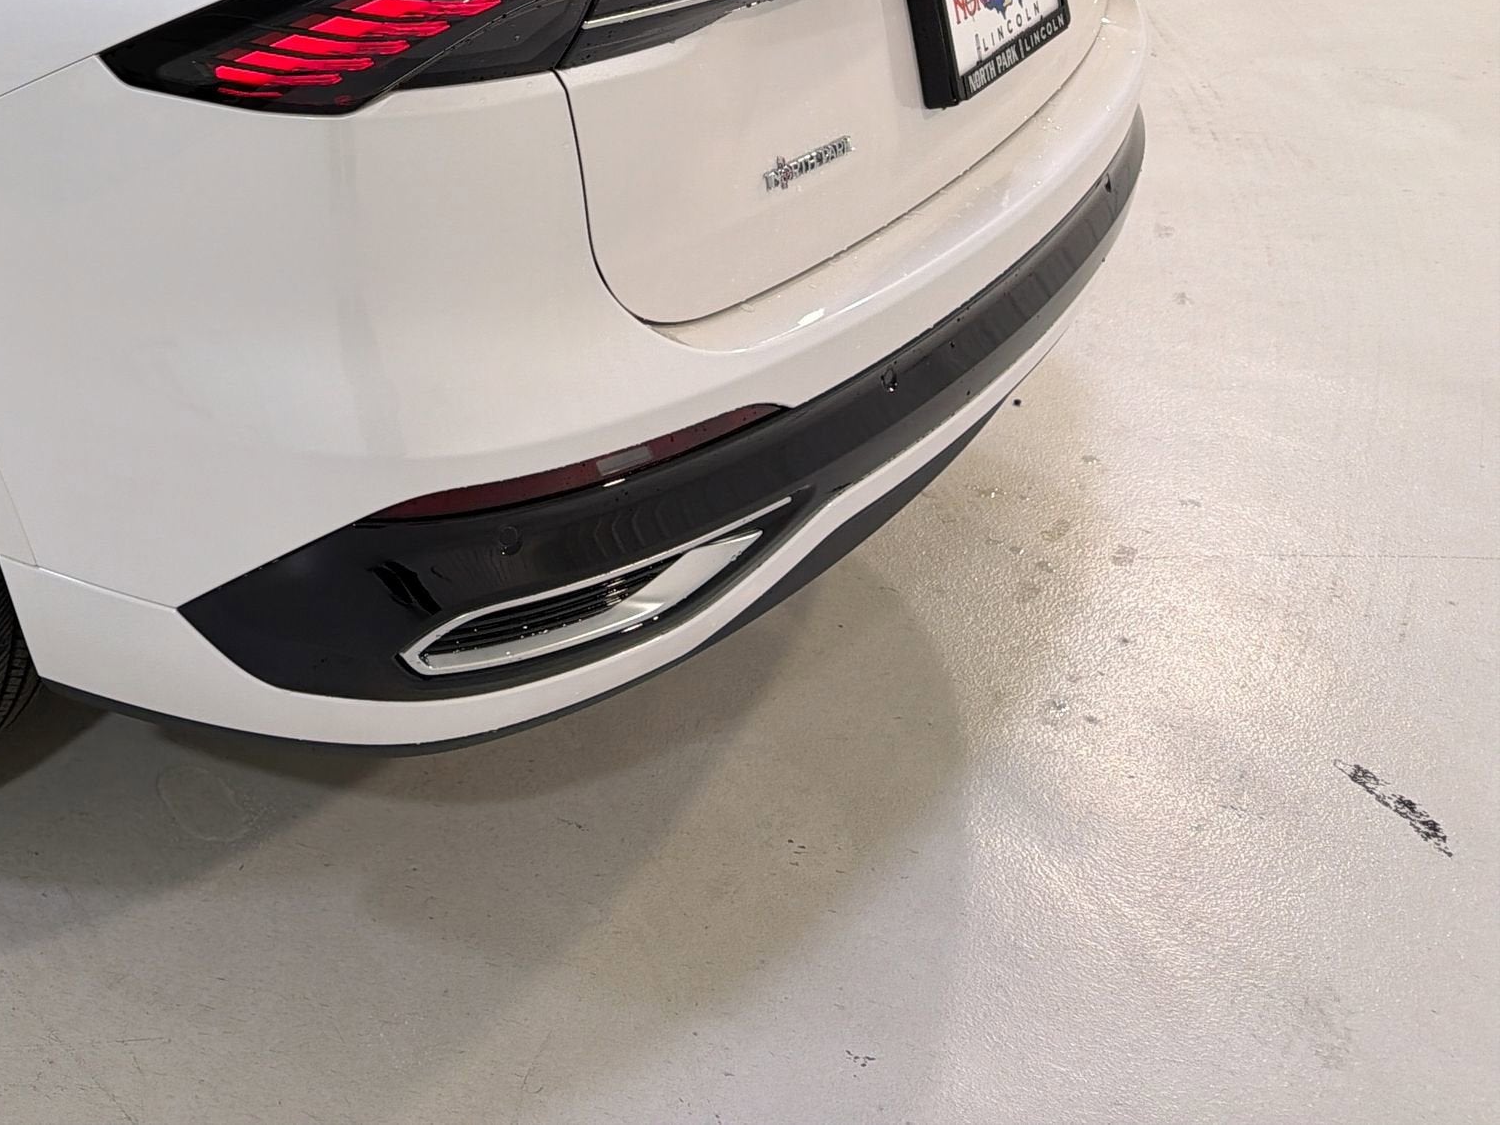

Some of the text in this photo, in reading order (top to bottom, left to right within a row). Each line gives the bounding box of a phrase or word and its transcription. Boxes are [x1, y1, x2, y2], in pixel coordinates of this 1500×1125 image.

[968, 14, 1065, 93] NORTH PARK LINCOLN
[983, 1, 1040, 51] LINCOLN
